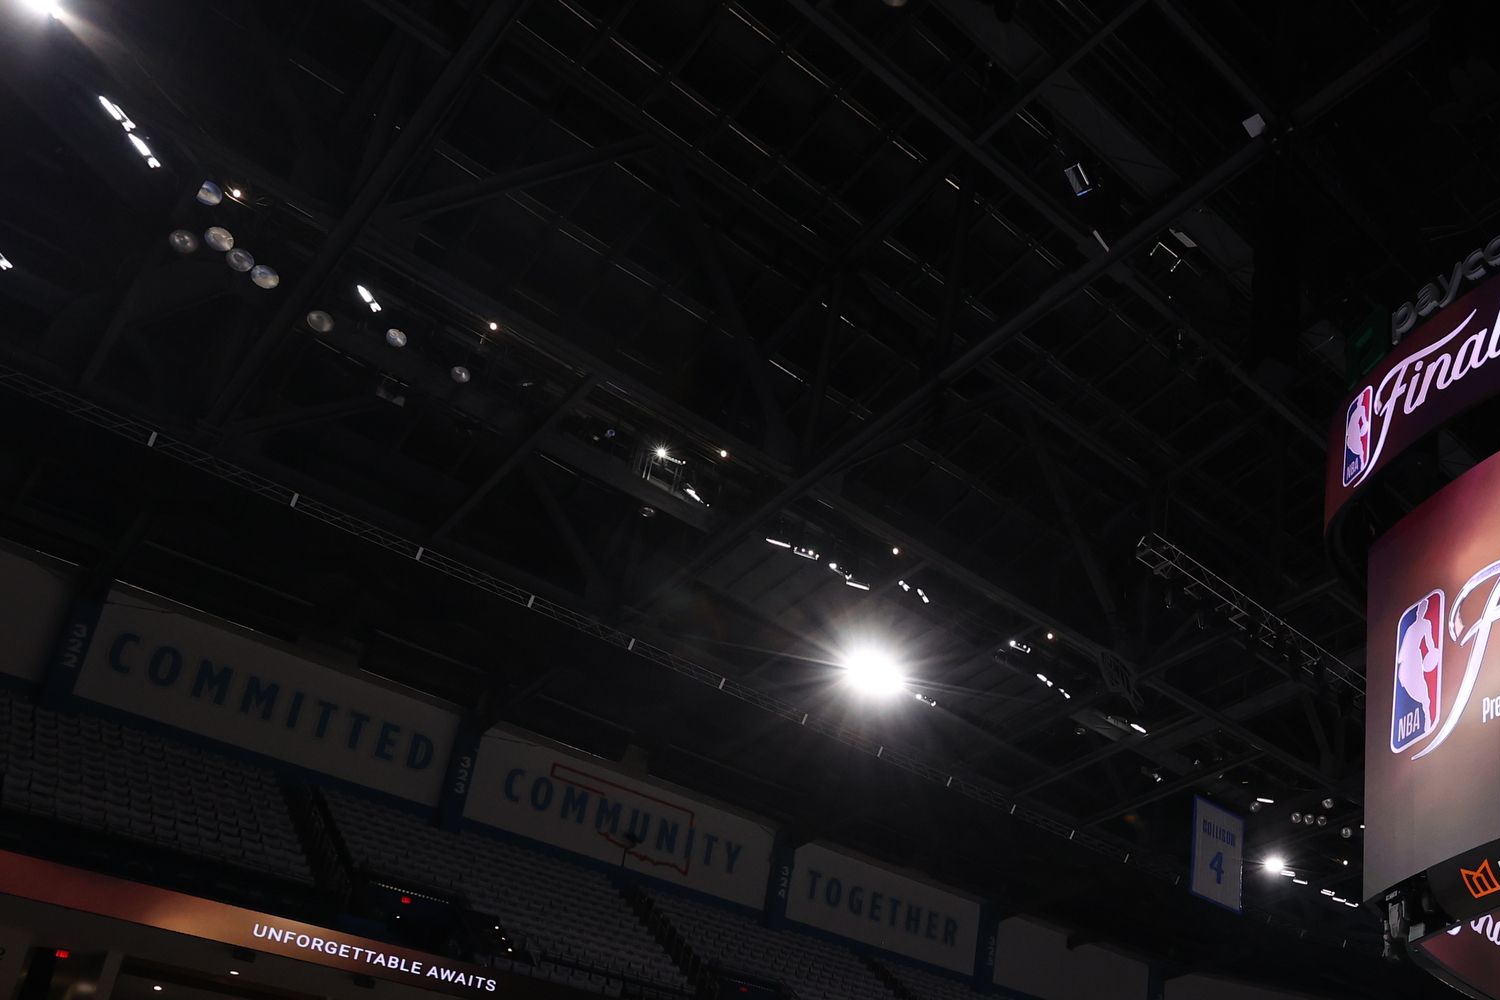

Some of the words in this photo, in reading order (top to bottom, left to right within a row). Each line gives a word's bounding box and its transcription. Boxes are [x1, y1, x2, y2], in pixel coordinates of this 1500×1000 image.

[108, 632, 436, 770] COMMITTED
[1398, 706, 1420, 742] NBA
[504, 768, 744, 874] COMMUNITY
[1209, 852, 1224, 884] 4
[807, 870, 959, 948] TOGETHER
[253, 923, 421, 976] UNFORGETTABLE
[426, 965, 497, 992] AWAITS
